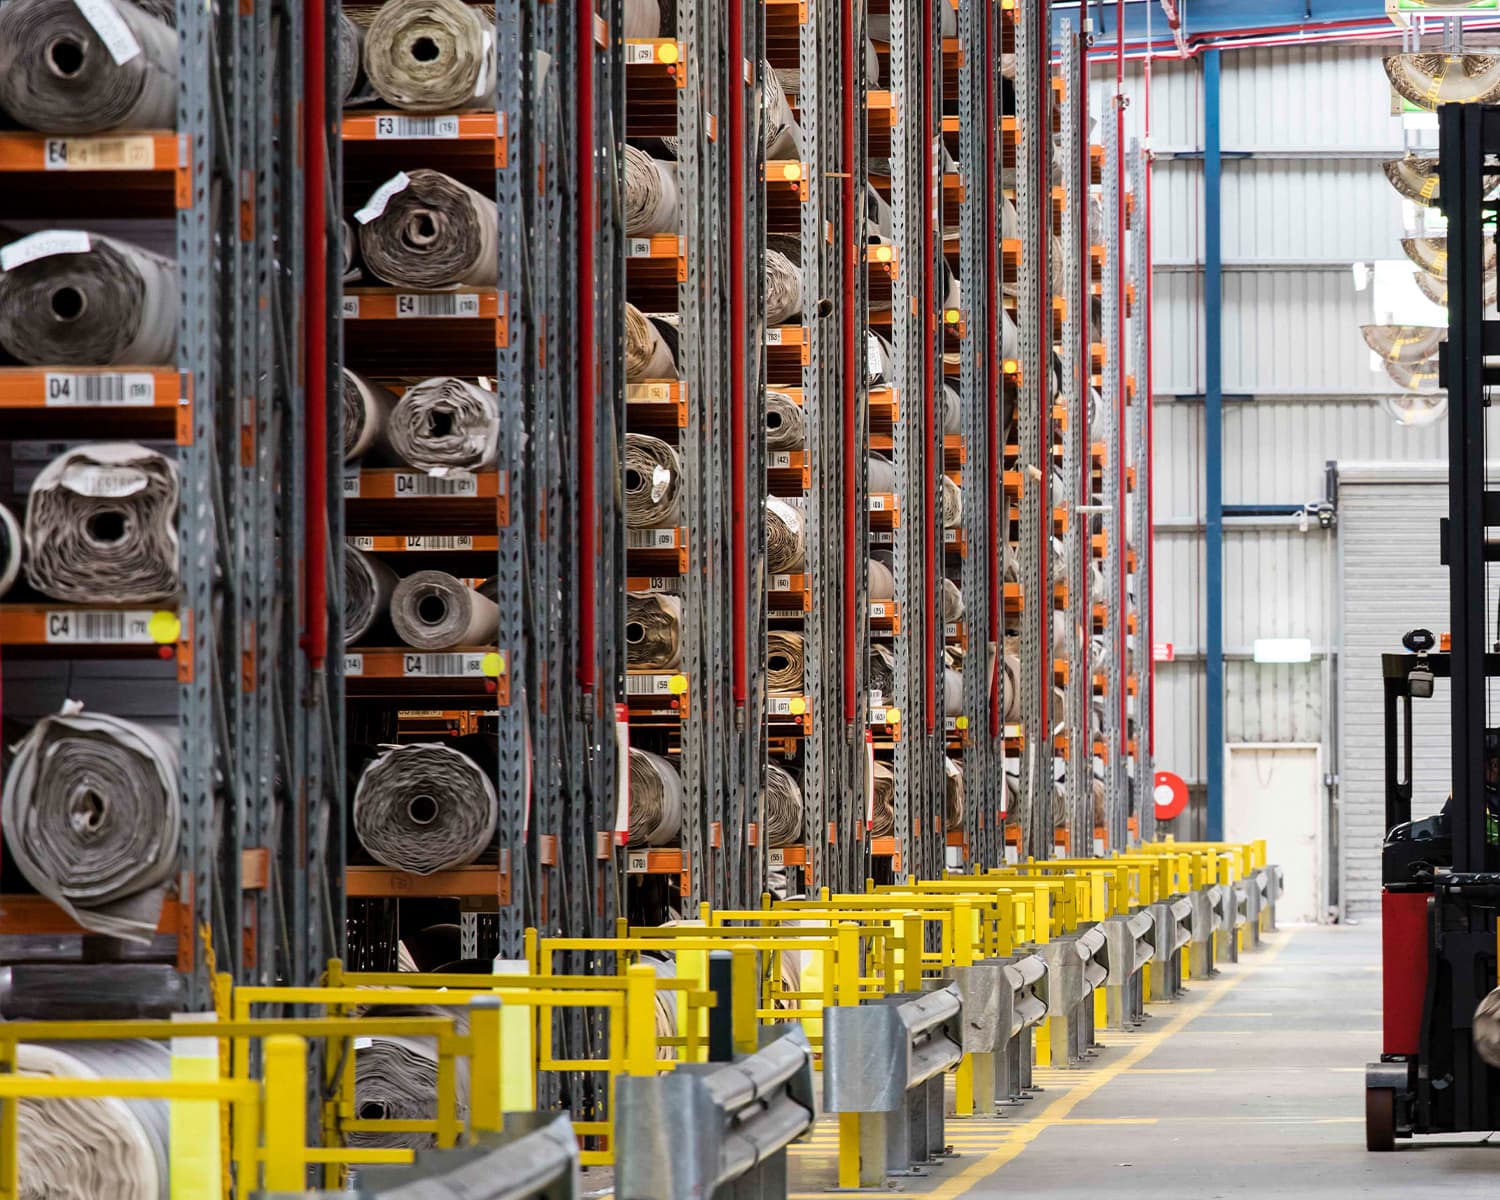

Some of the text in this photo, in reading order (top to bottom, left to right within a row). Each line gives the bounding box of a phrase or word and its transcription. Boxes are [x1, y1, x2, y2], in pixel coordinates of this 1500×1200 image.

[638, 48, 651, 59] (29)
[379, 118, 393, 134] F3
[400, 297, 413, 312] E4
[50, 378, 70, 399] D4
[777, 456, 789, 465] (42)
[398, 476, 413, 492] D4
[408, 536, 421, 547] D2
[651, 577, 663, 588] D3
[50, 615, 69, 637] C4
[407, 657, 481, 673] C4 (68
[656, 679, 667, 690] (59
